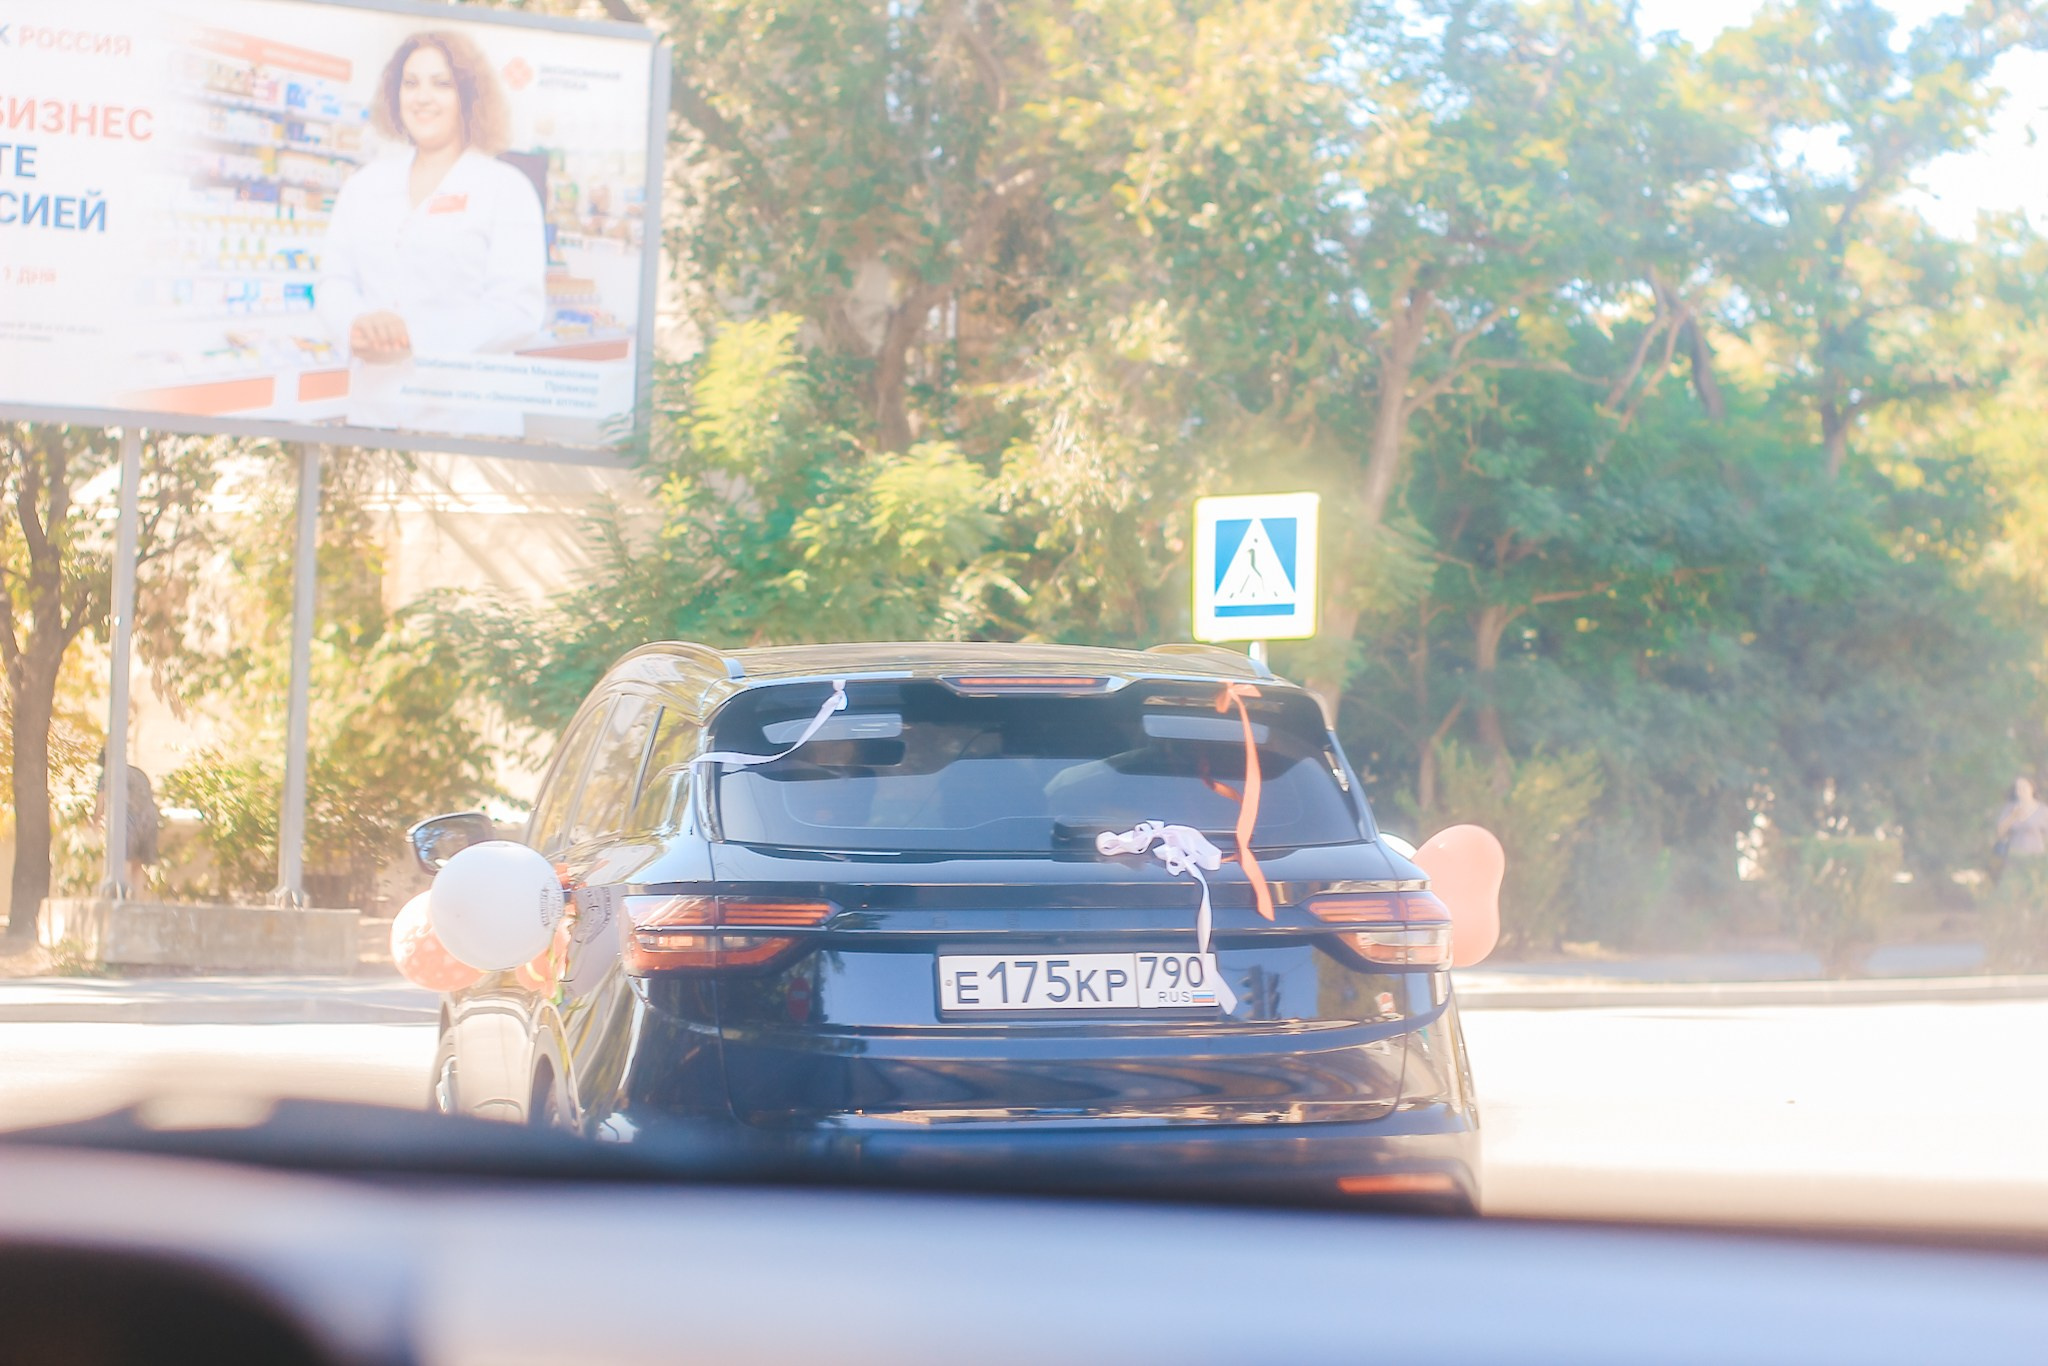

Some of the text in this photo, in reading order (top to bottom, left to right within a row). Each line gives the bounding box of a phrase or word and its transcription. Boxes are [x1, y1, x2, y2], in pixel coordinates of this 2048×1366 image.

[18, 26, 132, 56] РОССИЯ
[0, 97, 153, 140] ИЗНЕС
[0, 189, 106, 232] СИЕЙ
[955, 956, 1204, 1003] Е175КР 790
[1158, 991, 1190, 1003] RUS
